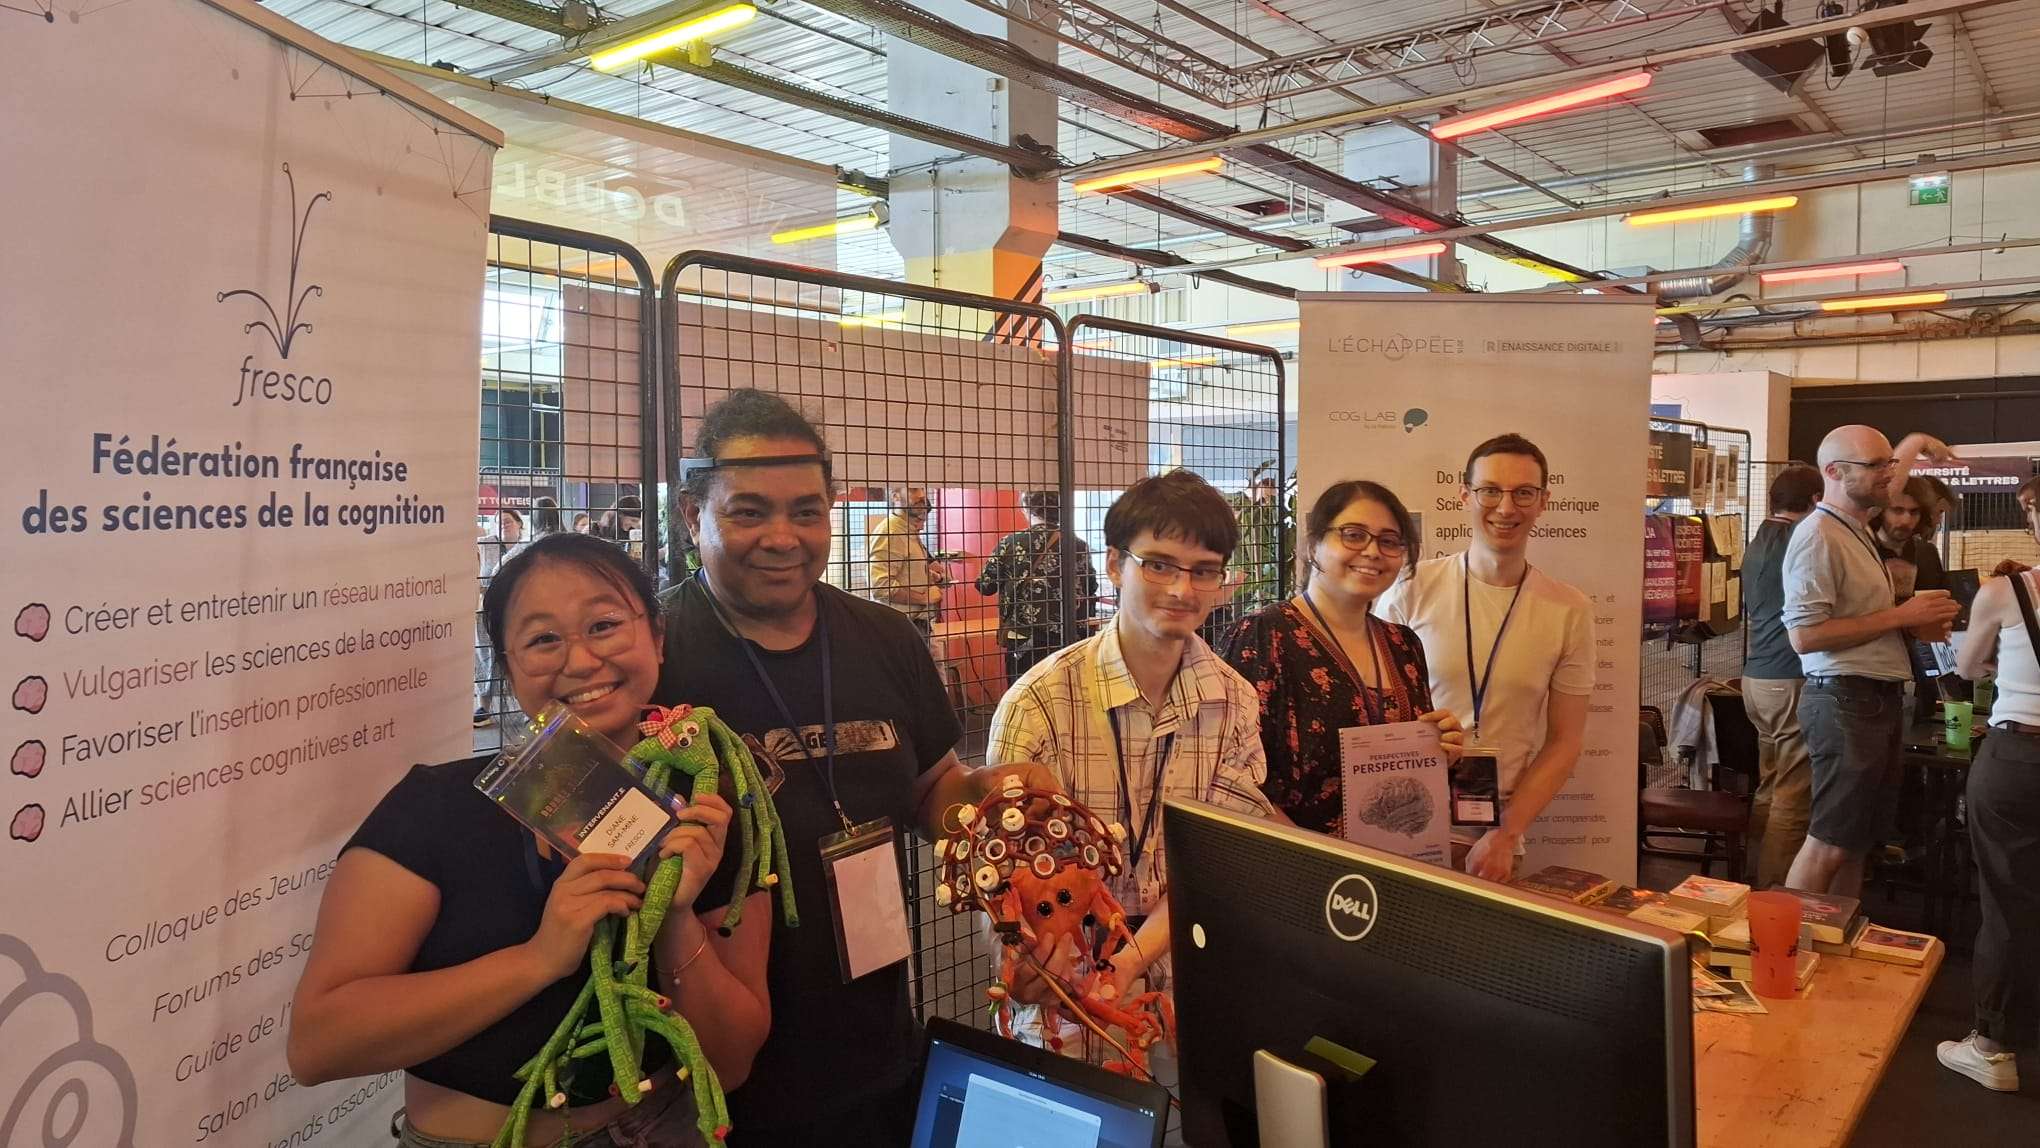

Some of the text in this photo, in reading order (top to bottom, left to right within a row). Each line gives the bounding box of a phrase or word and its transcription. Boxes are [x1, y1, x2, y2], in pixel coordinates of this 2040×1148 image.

[1568, 342, 1611, 352] DIGITALE
[233, 355, 332, 407] fresco
[91, 432, 408, 489] Fédération française
[1436, 470, 1453, 484] Do
[1961, 476, 2020, 486] LETTRES
[22, 489, 445, 535] des sciences de la cognition
[1436, 498, 1464, 511] Scie
[1529, 524, 1587, 538] Sciences
[64, 574, 447, 635] Créer et entretenir un réseau national
[63, 620, 453, 701] Vulgariser les sciences de la cognition
[61, 669, 428, 766] Favoriser l'insertion professionnelle
[59, 719, 397, 828] Allier sciences cognitives et art
[1352, 757, 1438, 775] PERSPECTIVES
[1369, 751, 1420, 761] PERSPECTIVES
[605, 813, 627, 836] DIANE
[104, 858, 338, 963] Colloque des Jeunes
[1331, 893, 1370, 920] DELL
[152, 933, 313, 1023] Forums des Sc
[175, 1031, 242, 1083] Guide
[248, 1012, 275, 1043] de
[197, 1090, 258, 1143] Salon
